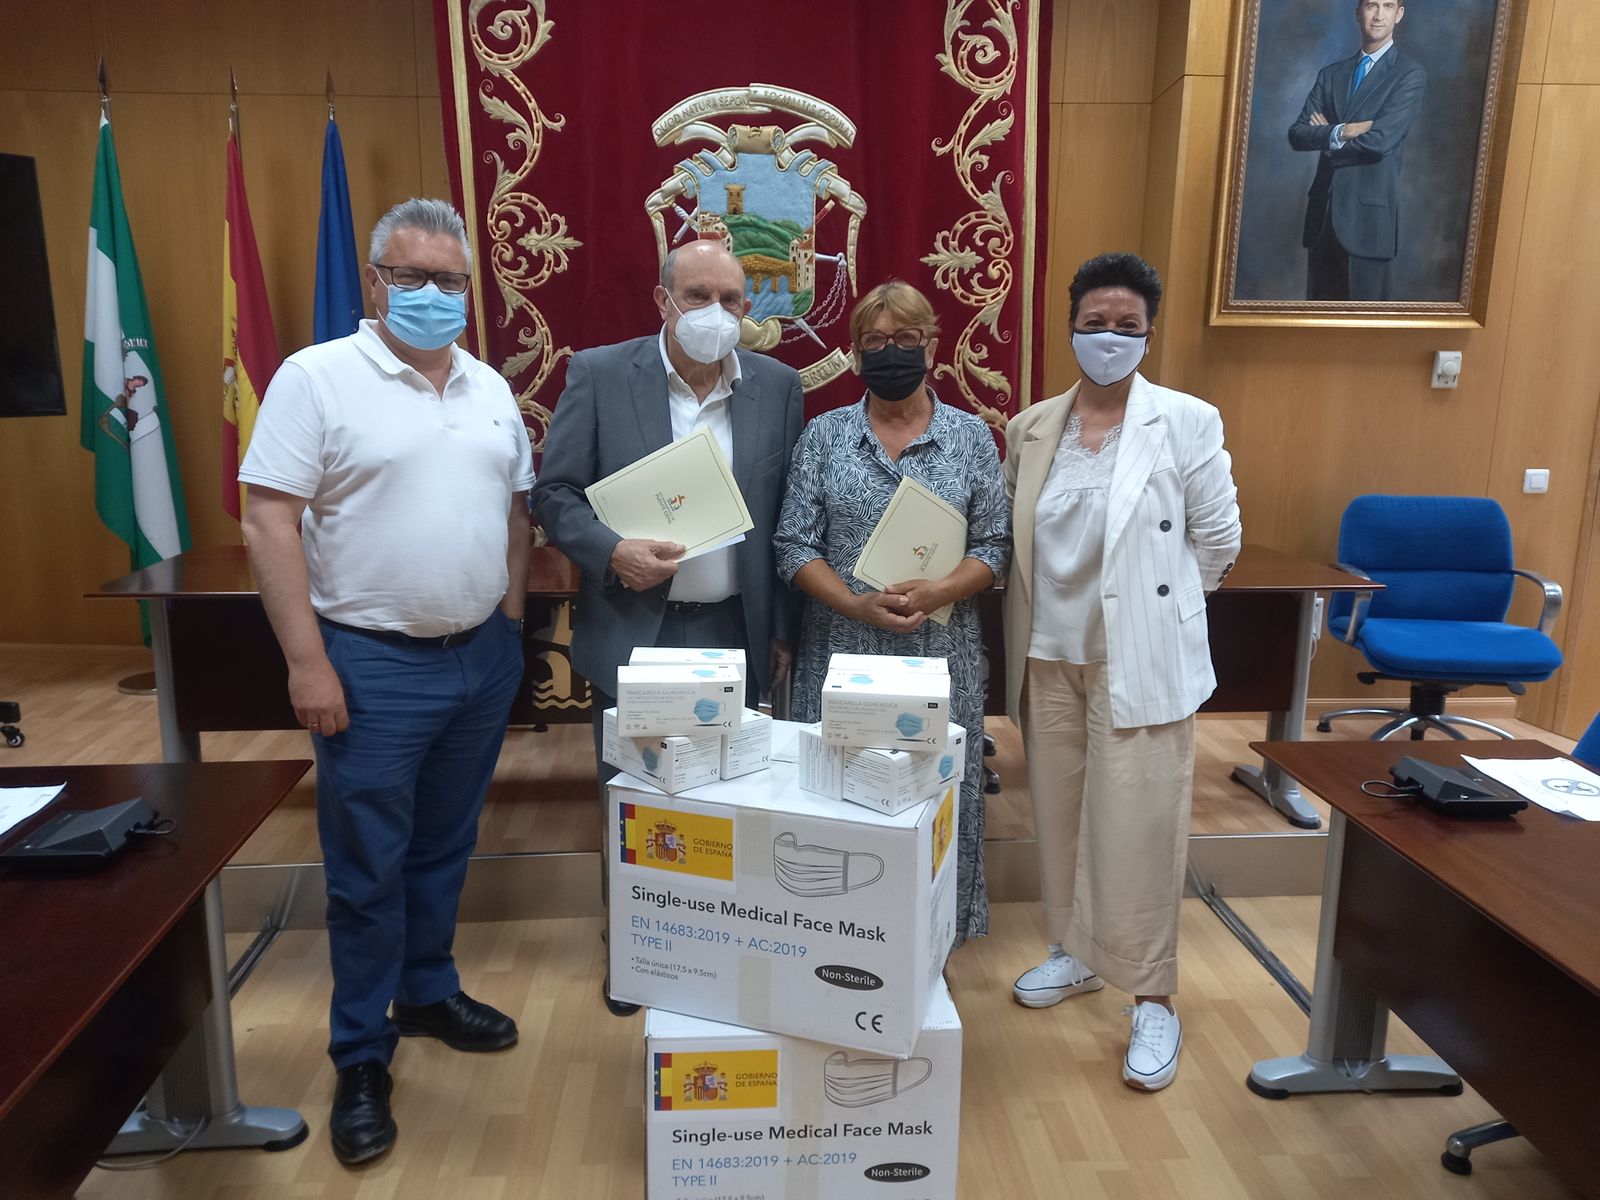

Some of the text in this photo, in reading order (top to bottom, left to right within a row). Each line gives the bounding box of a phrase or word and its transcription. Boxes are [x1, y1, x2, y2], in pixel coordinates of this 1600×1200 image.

[655, 113, 680, 136] QUOD
[682, 99, 718, 118] NATURA
[820, 109, 854, 139] COPULAT
[692, 838, 733, 850] GOBIERNO
[693, 846, 733, 858] DE ESPAÑA
[631, 885, 887, 943] Single-use Medical Face Mask
[631, 915, 807, 957] EN 14683:2019 + AC:2019
[631, 933, 672, 951] TYPE II
[635, 956, 651, 967] Talla
[651, 959, 669, 970] única
[635, 965, 679, 980] Con elásticos
[821, 968, 876, 987] Non-Sterile
[855, 1011, 883, 1034] CE
[735, 1072, 777, 1080] GOBIERNO
[748, 1079, 777, 1087] ESPAÑA
[672, 1120, 933, 1146] Single-use Medical Face Mask
[672, 1152, 857, 1170] EN 14683:2019 + AC:2019
[871, 1167, 923, 1177] Non-Sterile
[671, 1175, 717, 1188] TYPE II
